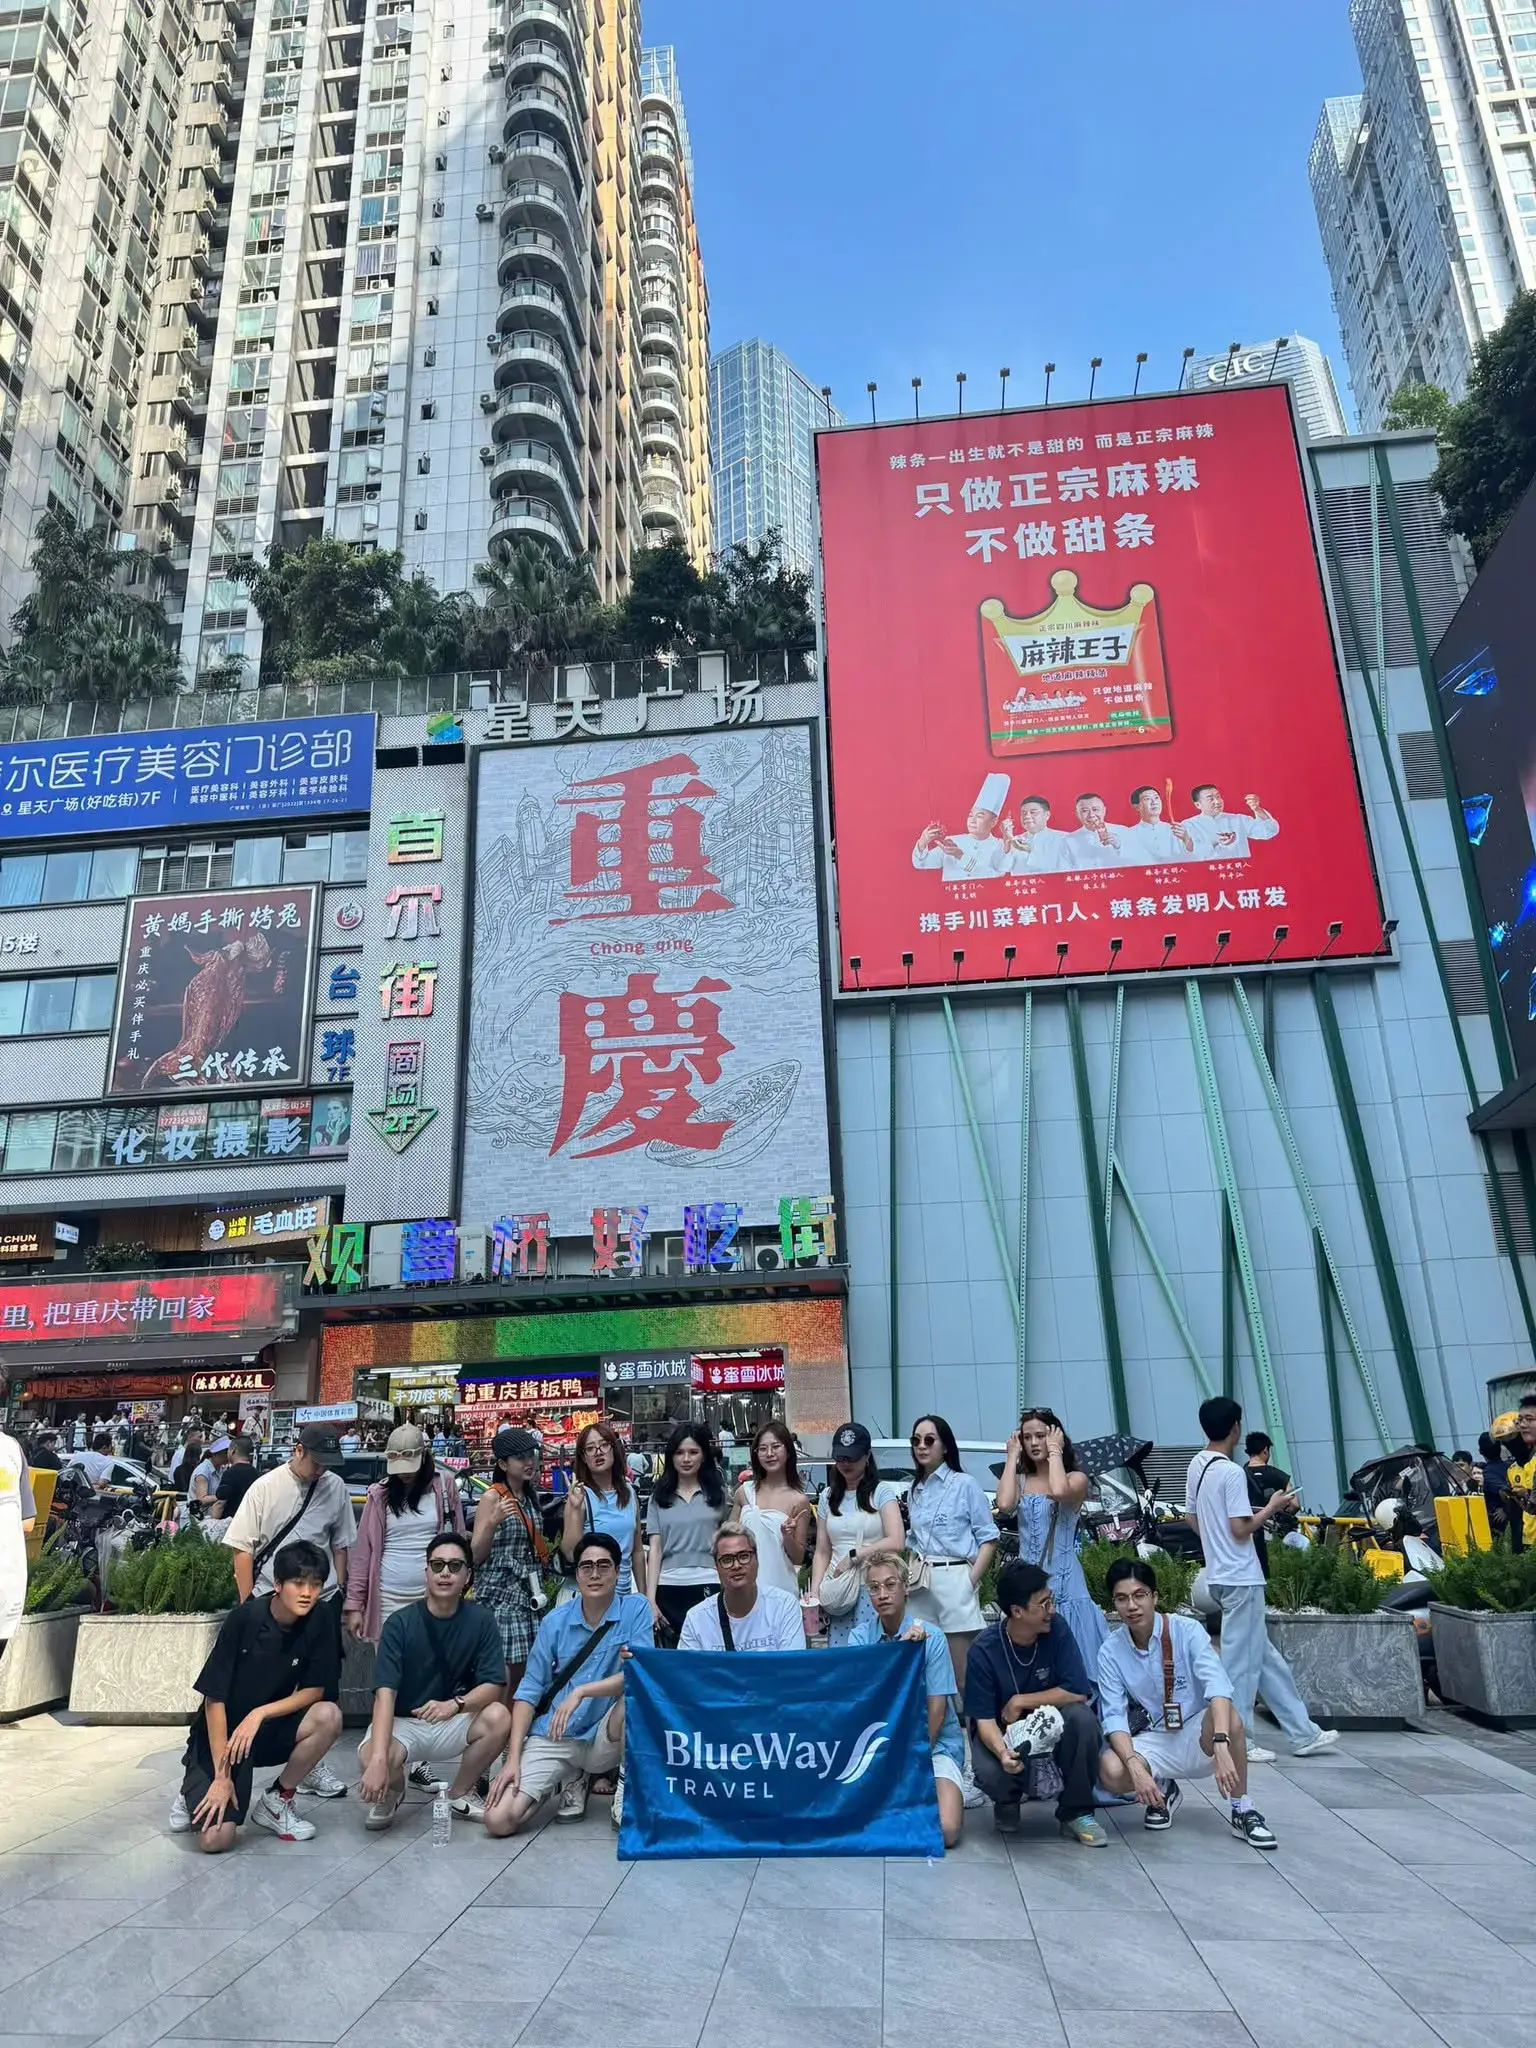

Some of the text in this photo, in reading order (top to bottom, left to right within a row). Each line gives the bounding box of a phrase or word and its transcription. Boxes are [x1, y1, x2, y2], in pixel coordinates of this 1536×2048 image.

[889, 423, 1215, 470] 辣条一出生就不是甜的 而是正宗麻辣
[915, 456, 1200, 518] 只做正宗麻辣
[965, 512, 1156, 563] 不做甜条
[1020, 635, 1128, 668] 麻辣王子
[483, 680, 764, 745] 星天广场
[0, 729, 353, 793] 尔医疗美容门诊部
[920, 886, 1288, 933] 携手川菜掌门人、辣条发明人研发
[0, 932, 38, 953] 5楼
[127, 946, 152, 1060] 重庆必买伴手礼
[320, 964, 360, 1063] 台球
[172, 1046, 292, 1081] 三代传承
[327, 1066, 350, 1082] 7F
[385, 1048, 419, 1133] 商场 2F
[111, 1116, 303, 1165] 化妆摄影
[4, 1234, 37, 1243] CHUN
[253, 1206, 318, 1235] 毛血旺
[303, 1195, 837, 1285] 观音桥好吃街
[477, 1378, 583, 1402] 重庆酱板鸭
[619, 1359, 687, 1380] 蜜雪冰城
[723, 1365, 785, 1384] 蜜雪冰城
[664, 1729, 842, 1779] BlueWay
[665, 1777, 774, 1799] TRAVEL
